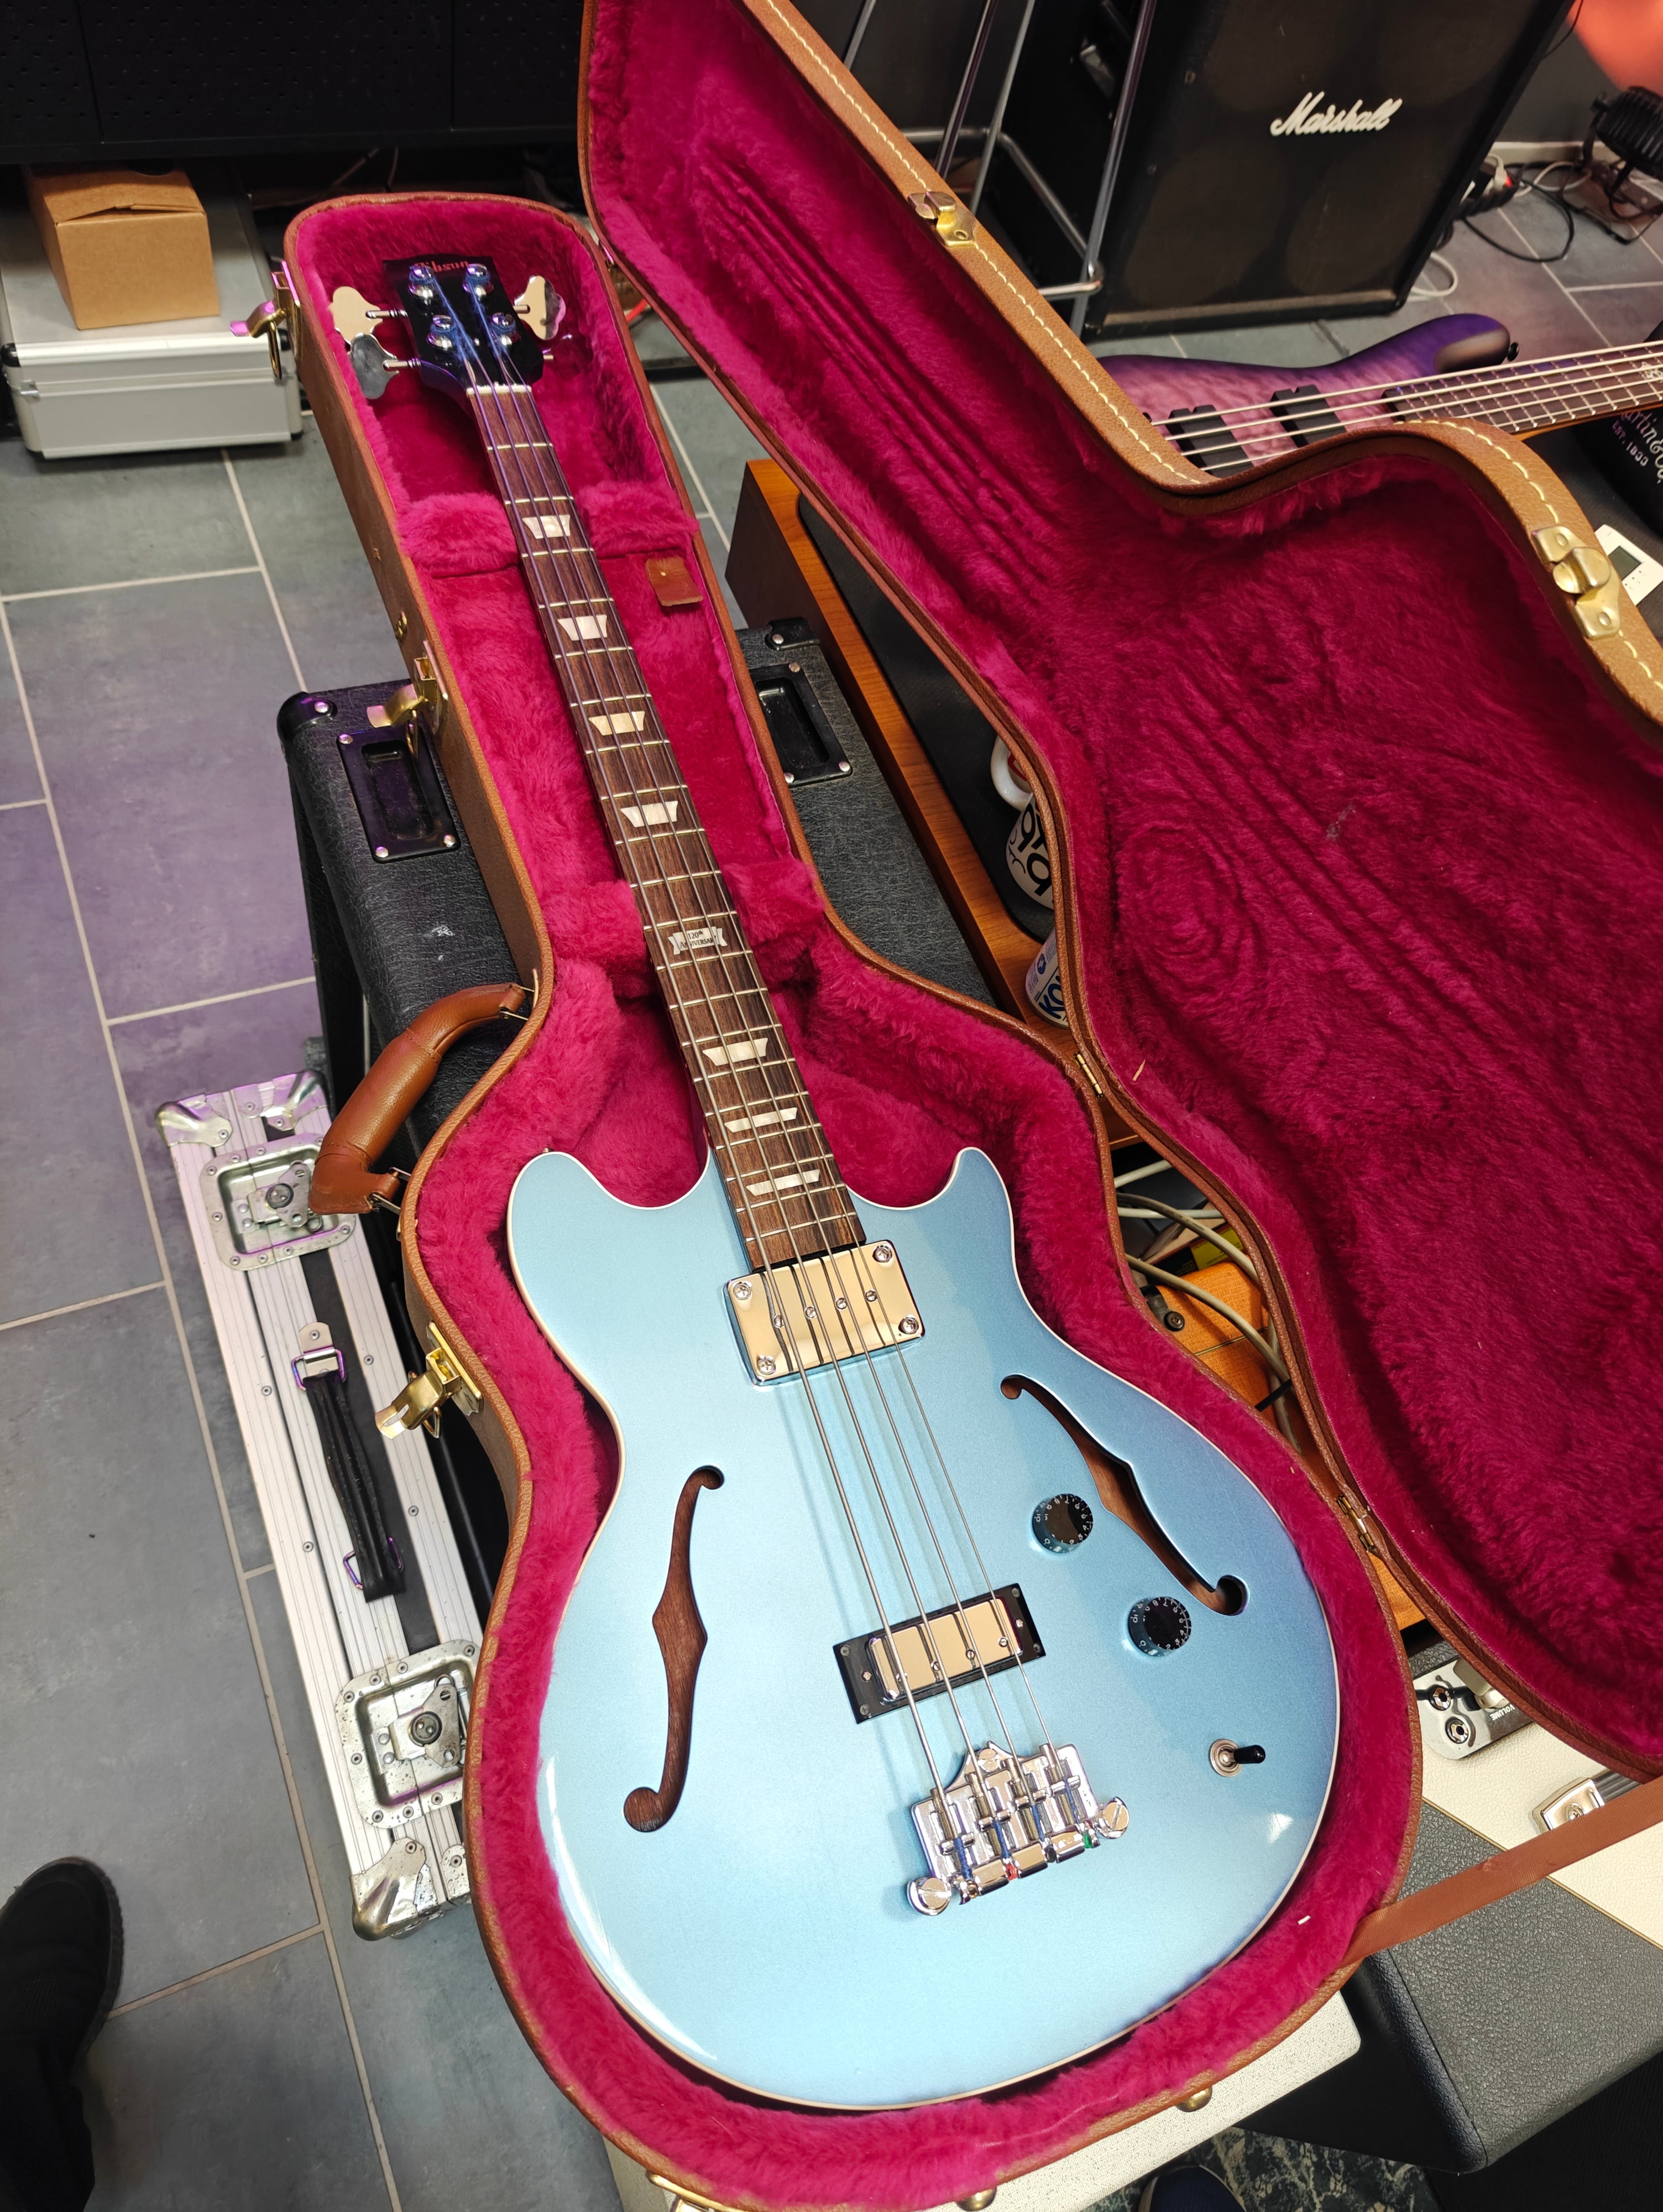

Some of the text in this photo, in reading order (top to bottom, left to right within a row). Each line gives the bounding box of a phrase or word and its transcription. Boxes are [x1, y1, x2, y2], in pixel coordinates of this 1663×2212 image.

[1270, 91, 1403, 136] Marshall
[1621, 411, 1657, 444] artin
[1489, 1704, 1515, 1721] VOLUME
